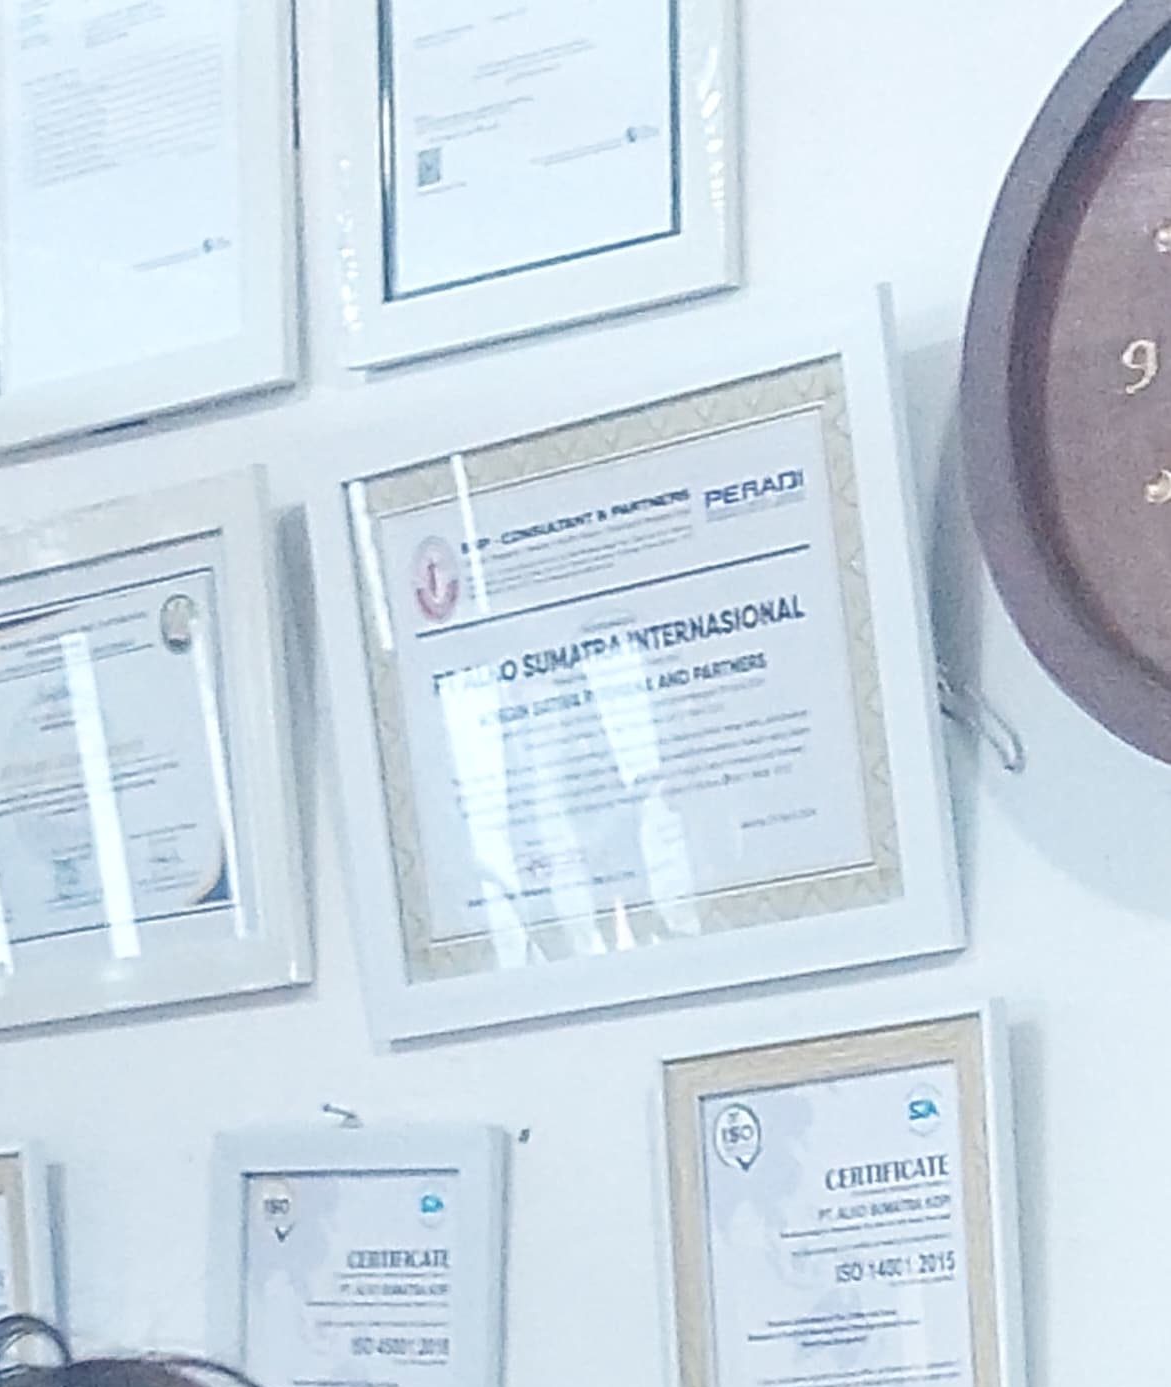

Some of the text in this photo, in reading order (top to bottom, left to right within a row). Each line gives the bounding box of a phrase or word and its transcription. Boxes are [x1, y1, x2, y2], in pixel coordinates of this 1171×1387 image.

[704, 468, 805, 508] PERADI
[523, 634, 621, 678] SUMATRA
[627, 594, 806, 650] INTERNASIONAL
[825, 1153, 950, 1191] CERTIFICATE
[346, 1248, 450, 1269] CERTIFICATE
[835, 1261, 864, 1283] ISO
